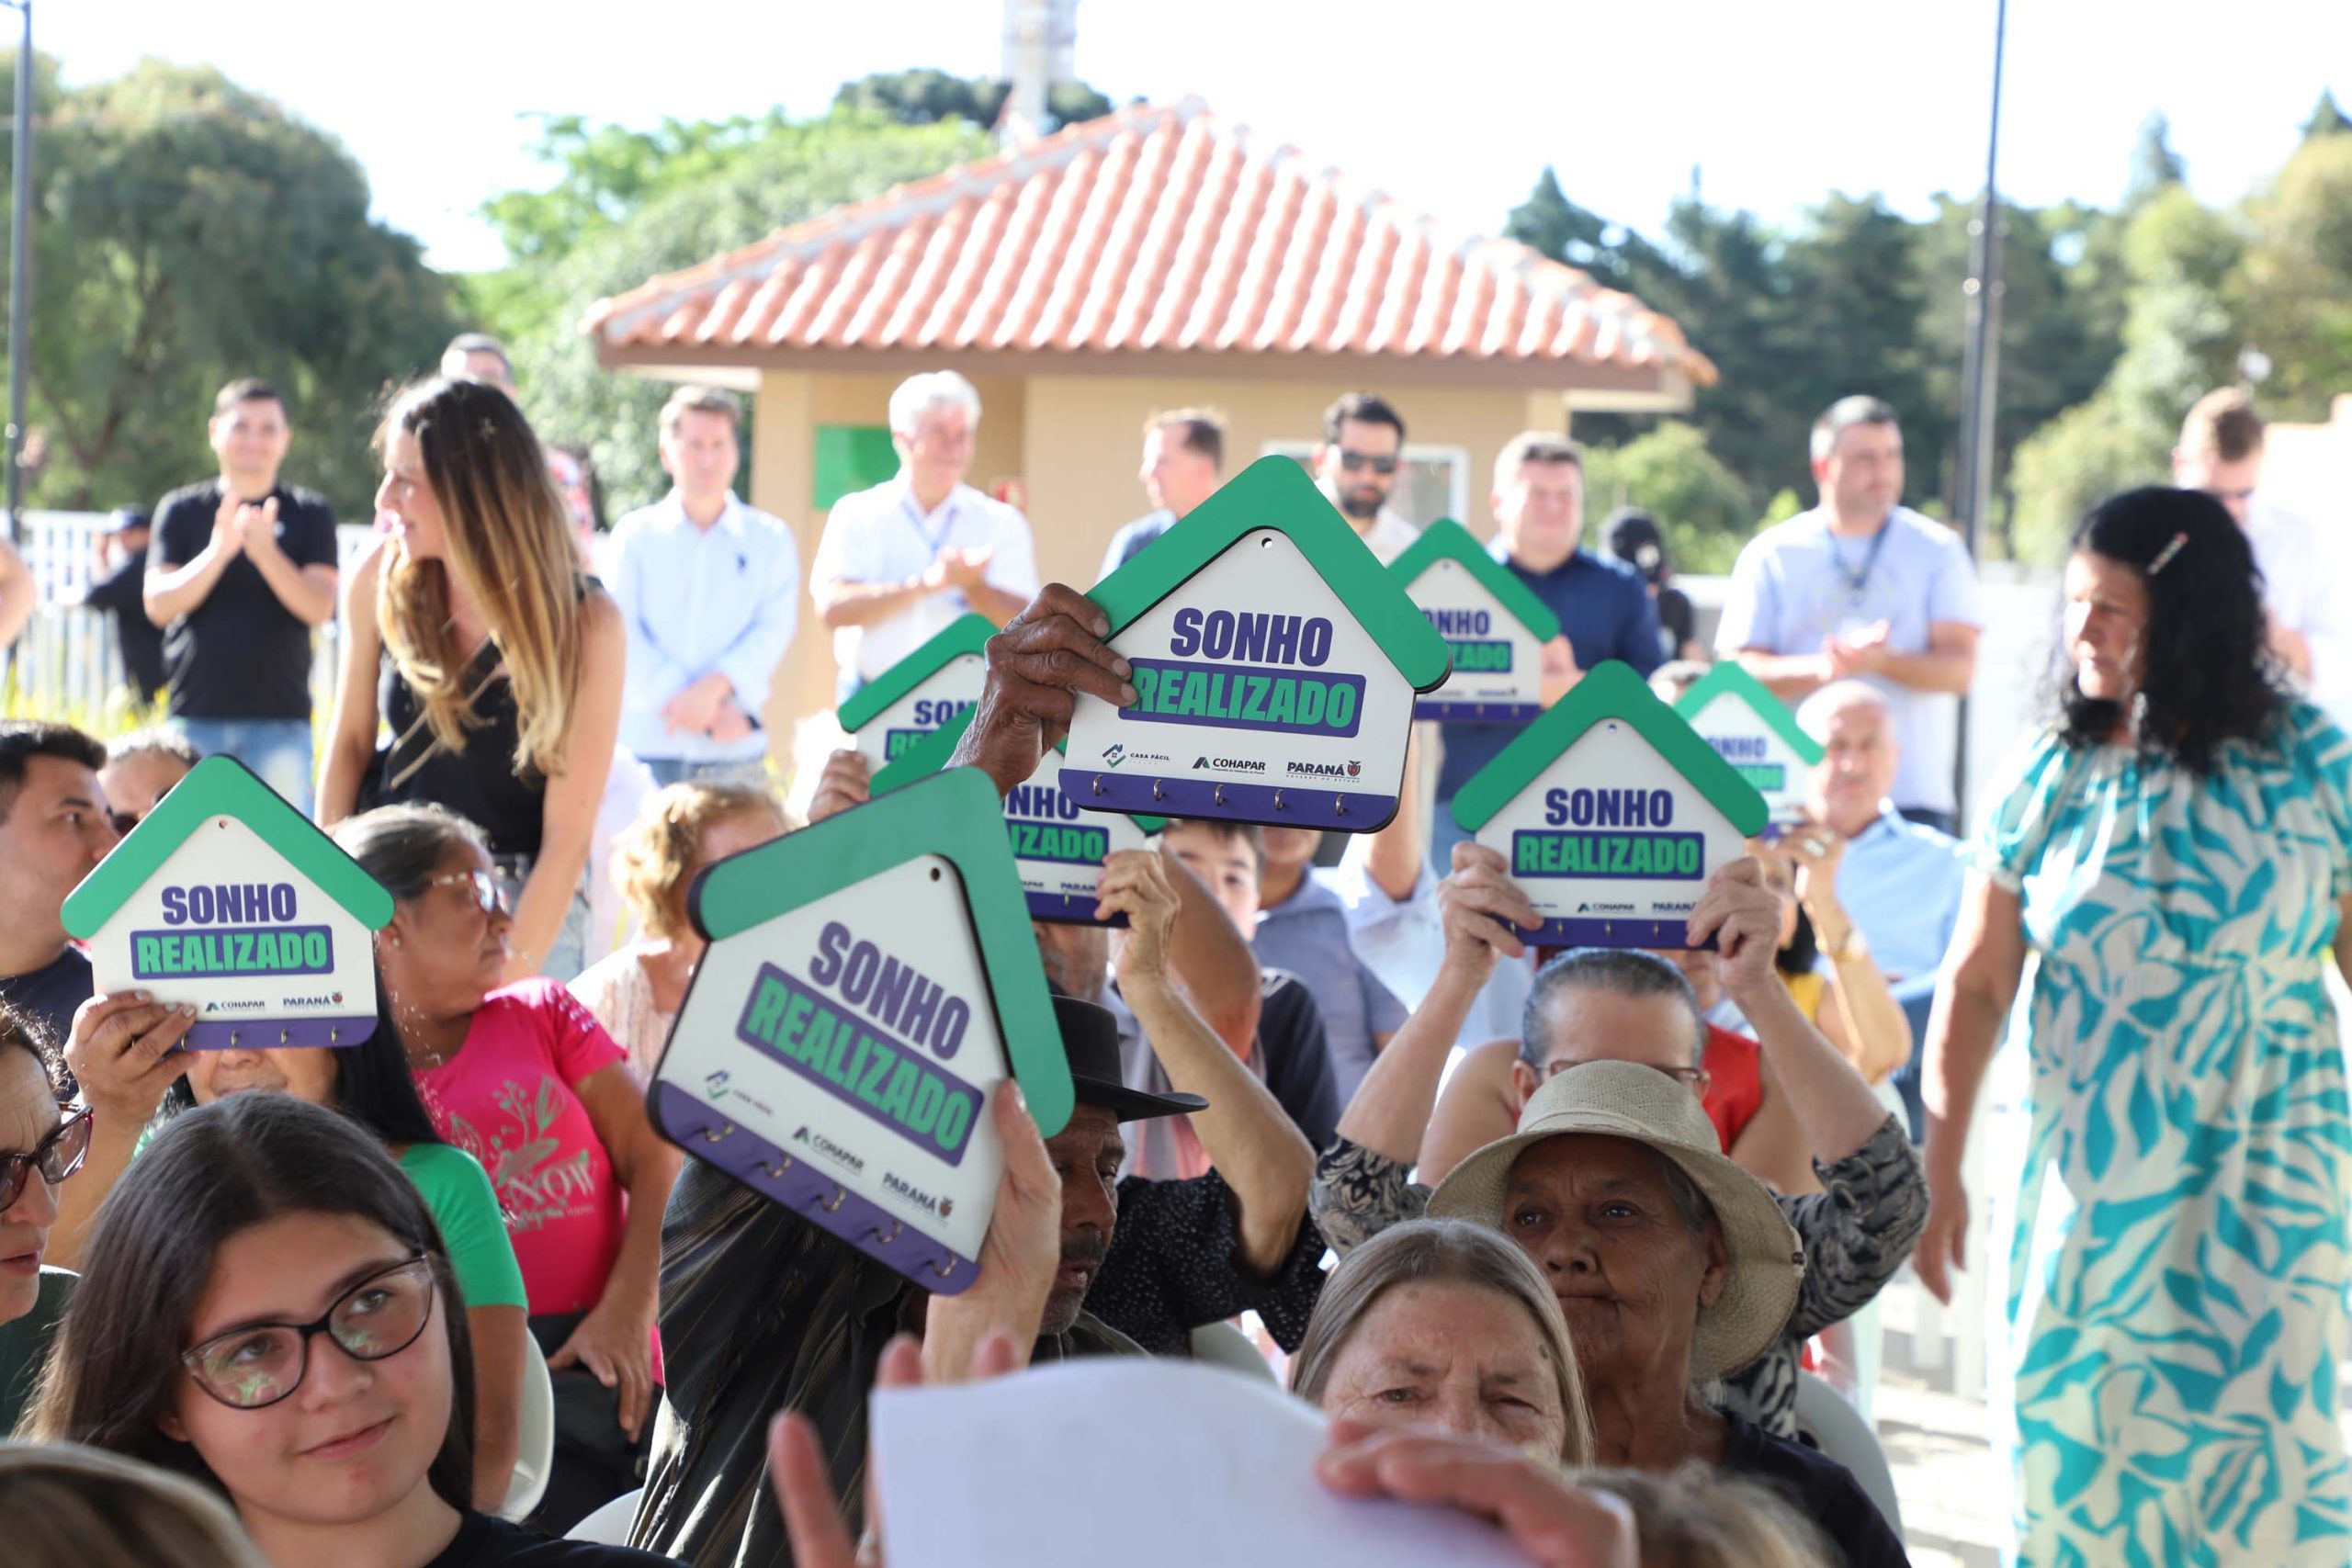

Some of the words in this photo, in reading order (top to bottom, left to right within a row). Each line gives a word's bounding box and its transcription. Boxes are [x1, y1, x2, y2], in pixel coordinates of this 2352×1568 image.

[1170, 607, 1333, 667] SONHO
[1423, 609, 1490, 635] NHO
[1129, 667, 1357, 728] REALIZADO
[1213, 758, 1266, 771] COHAPAR
[1287, 761, 1345, 775] PARANÁ
[1008, 784, 1080, 820] NHO
[1544, 787, 1673, 828] SONHO
[1011, 824, 1105, 862] IZADO
[1518, 835, 1700, 874] REALIZADO
[161, 883, 298, 925] SONHO
[1060, 882, 1097, 891] PARAN
[136, 930, 328, 974] REALIZADO
[221, 1000, 266, 1010] COHAPAR
[283, 994, 331, 1007] PARANÁ
[808, 920, 971, 1061] SONHO
[744, 974, 975, 1152] REALIZADO
